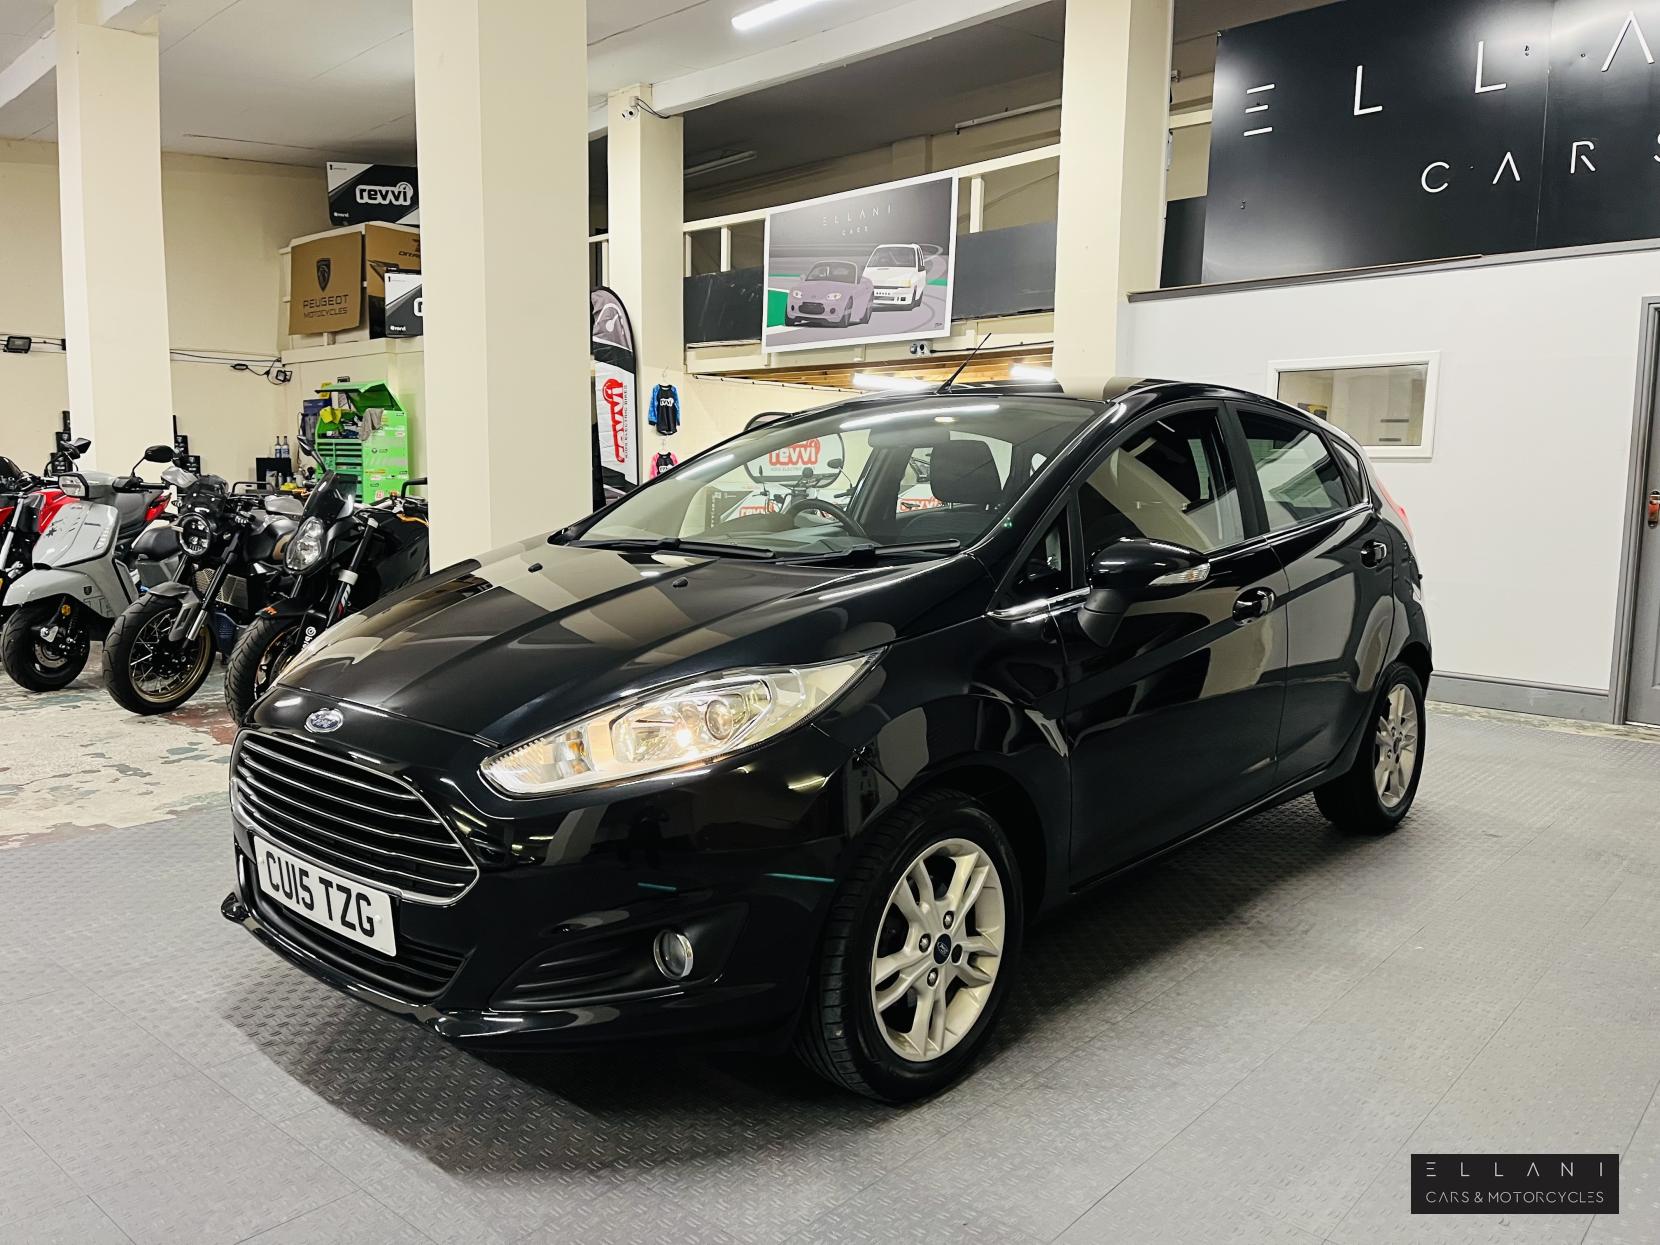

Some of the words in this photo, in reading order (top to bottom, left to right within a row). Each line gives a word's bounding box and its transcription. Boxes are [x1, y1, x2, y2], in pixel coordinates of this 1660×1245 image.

[357, 183, 411, 205] revvi
[823, 203, 891, 227] ELLANI
[303, 294, 349, 309] PEUGEOT
[769, 439, 819, 465] revvi
[266, 851, 315, 912] CU15
[318, 876, 375, 938] TZG
